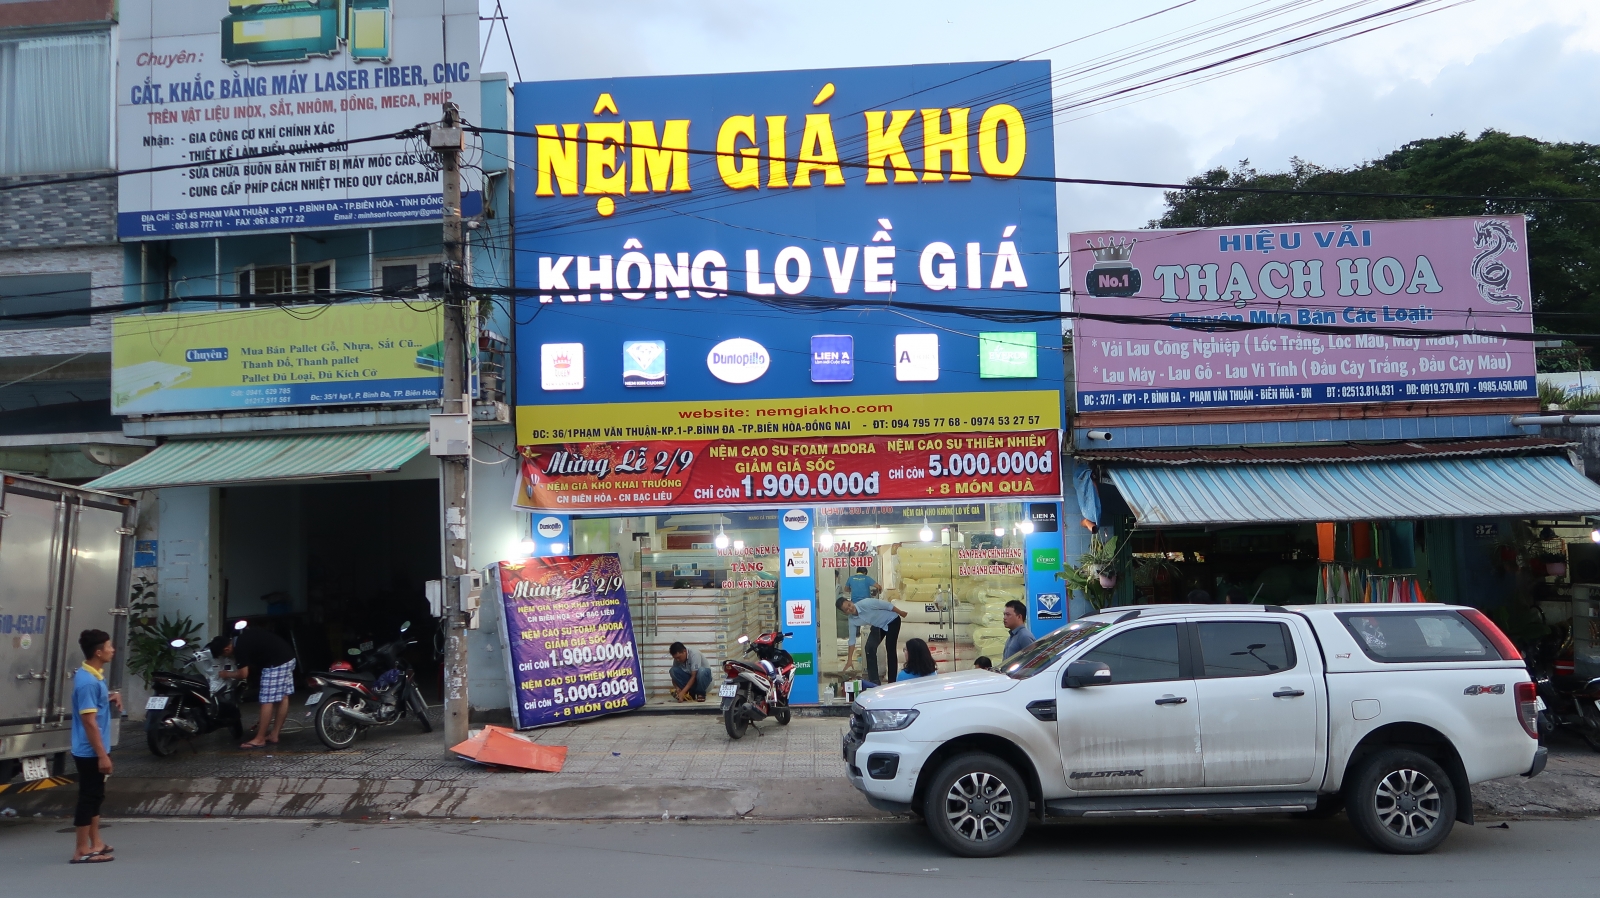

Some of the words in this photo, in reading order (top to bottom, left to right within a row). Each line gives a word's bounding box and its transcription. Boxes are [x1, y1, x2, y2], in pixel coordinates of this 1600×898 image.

[131, 76, 164, 105] CẮT,
[169, 73, 214, 102] KHẮC
[220, 70, 267, 99] BẰNG
[272, 69, 308, 95] MÁY
[315, 69, 369, 92] LASER
[375, 65, 428, 88] FIBER,
[433, 61, 470, 83] CNC
[147, 109, 178, 125] TRÊN
[181, 107, 201, 123] VẬT
[205, 105, 230, 122] LIỆU
[234, 104, 266, 119] INOX,
[269, 98, 294, 116] SẮT,
[297, 98, 337, 115] NHÔM,
[340, 93, 378, 111] ĐỒNG,
[381, 94, 420, 109] MECA,
[189, 133, 206, 144] GIA
[210, 129, 238, 143] CÔNG
[279, 123, 311, 138] CHÍNH
[314, 122, 335, 135] XÁC
[534, 93, 692, 217] NỆM
[715, 82, 846, 191] GIÁ
[863, 103, 1027, 186] KHO
[189, 185, 218, 198] CUNG
[334, 176, 359, 189] THEO
[362, 174, 383, 187] QUY
[275, 206, 287, 214] KP
[142, 224, 157, 232] TEL
[236, 218, 251, 227] FAX
[1219, 229, 1301, 254] HIỆU
[1313, 224, 1372, 248] VẢI
[538, 238, 728, 303] KHÔNG
[746, 246, 812, 296] LO
[822, 218, 897, 295] VỀ
[919, 224, 1028, 291] GIÁ
[1098, 274, 1129, 288] No.1
[1153, 259, 1325, 308] THẠCH
[1336, 255, 1443, 296] HOA
[1297, 308, 1336, 324] Bán
[1342, 306, 1377, 324] Các
[241, 347, 263, 355] Mua
[290, 344, 317, 353] Pallet
[1101, 340, 1123, 357] Vải
[1126, 341, 1150, 356] Lau
[1154, 339, 1190, 359] Công
[1193, 337, 1240, 358] Nghiệp
[1254, 334, 1277, 352] Lốc
[241, 360, 274, 369] Thanh
[296, 357, 328, 367] Thanh
[331, 356, 359, 367] pallet
[712, 352, 765, 366] Dunlopillo
[242, 374, 270, 383] Pallet
[1103, 368, 1124, 383] Lau
[1129, 367, 1156, 386] Máy
[1168, 366, 1190, 381] Lau
[1194, 362, 1212, 380] Gỗ
[1225, 364, 1247, 379] Lau
[1251, 363, 1265, 378] Vi
[1268, 360, 1297, 377] Tính
[1310, 358, 1336, 376] Đầu
[1340, 359, 1365, 379] Cây
[1369, 355, 1408, 377] Trắng
[1419, 354, 1445, 372] Đầu
[1449, 356, 1474, 375] Cây
[1100, 393, 1115, 405] 37/1
[1122, 393, 1136, 404] KP1
[1170, 391, 1181, 403] ĐA
[1189, 391, 1212, 404] PHẠM
[678, 408, 750, 419] website:
[756, 404, 893, 418] nemgiakho.com
[533, 429, 549, 439] ĐC:
[604, 426, 623, 437] VĂN
[722, 424, 735, 434] ĐA
[834, 420, 851, 430] NAI
[873, 419, 888, 429] ĐT:
[891, 419, 909, 428] 094
[913, 418, 930, 427] 795
[933, 418, 945, 427] 77
[948, 417, 961, 426] 68
[971, 416, 995, 426] 0974
[998, 416, 1010, 425] 53
[1013, 415, 1025, 425] 27
[1028, 415, 1040, 424] 57
[710, 444, 738, 460] NỆM
[741, 445, 768, 457] CAO
[772, 445, 789, 456] SU
[792, 444, 828, 455] FOAM
[832, 443, 876, 454] ADORA
[887, 438, 914, 453] NỆM
[918, 439, 942, 450] CAO
[946, 438, 962, 449] SU
[966, 435, 1003, 449] THIÊN
[1007, 434, 1046, 447] NHIÊN
[542, 450, 611, 478] Mừng
[615, 447, 648, 472] Lễ
[655, 448, 694, 476] 2/9
[735, 459, 772, 473] GIẢM
[776, 458, 802, 472] GIÁ
[806, 456, 835, 471] SỐC
[889, 466, 904, 479] CHỈ
[906, 466, 925, 479] CÒN
[928, 450, 1053, 476] 5.000.000đ
[591, 482, 612, 490] KHO
[615, 481, 639, 489] KHAI
[694, 485, 714, 499] CHỈ
[716, 485, 740, 499] CÒN
[741, 471, 880, 498] 1.900.000đ
[940, 485, 950, 494] 8
[955, 479, 993, 494] MÓN
[998, 478, 1034, 493] QUÀ
[633, 493, 650, 503] BẠC
[822, 557, 847, 568] FREE
[850, 556, 873, 568] SHIP
[567, 577, 592, 595] Lễ
[596, 576, 623, 596] 2/9
[542, 629, 559, 638] CAO
[561, 626, 572, 635] SU
[534, 659, 550, 670] CÒN
[549, 641, 634, 668] 1.900.000đ
[521, 679, 543, 691] NỆM
[554, 677, 639, 705] 5.000.000đ
[574, 701, 601, 714] MÓN
[604, 698, 629, 710] QUÀ
[1069, 769, 1145, 780] WILDSTRAK
